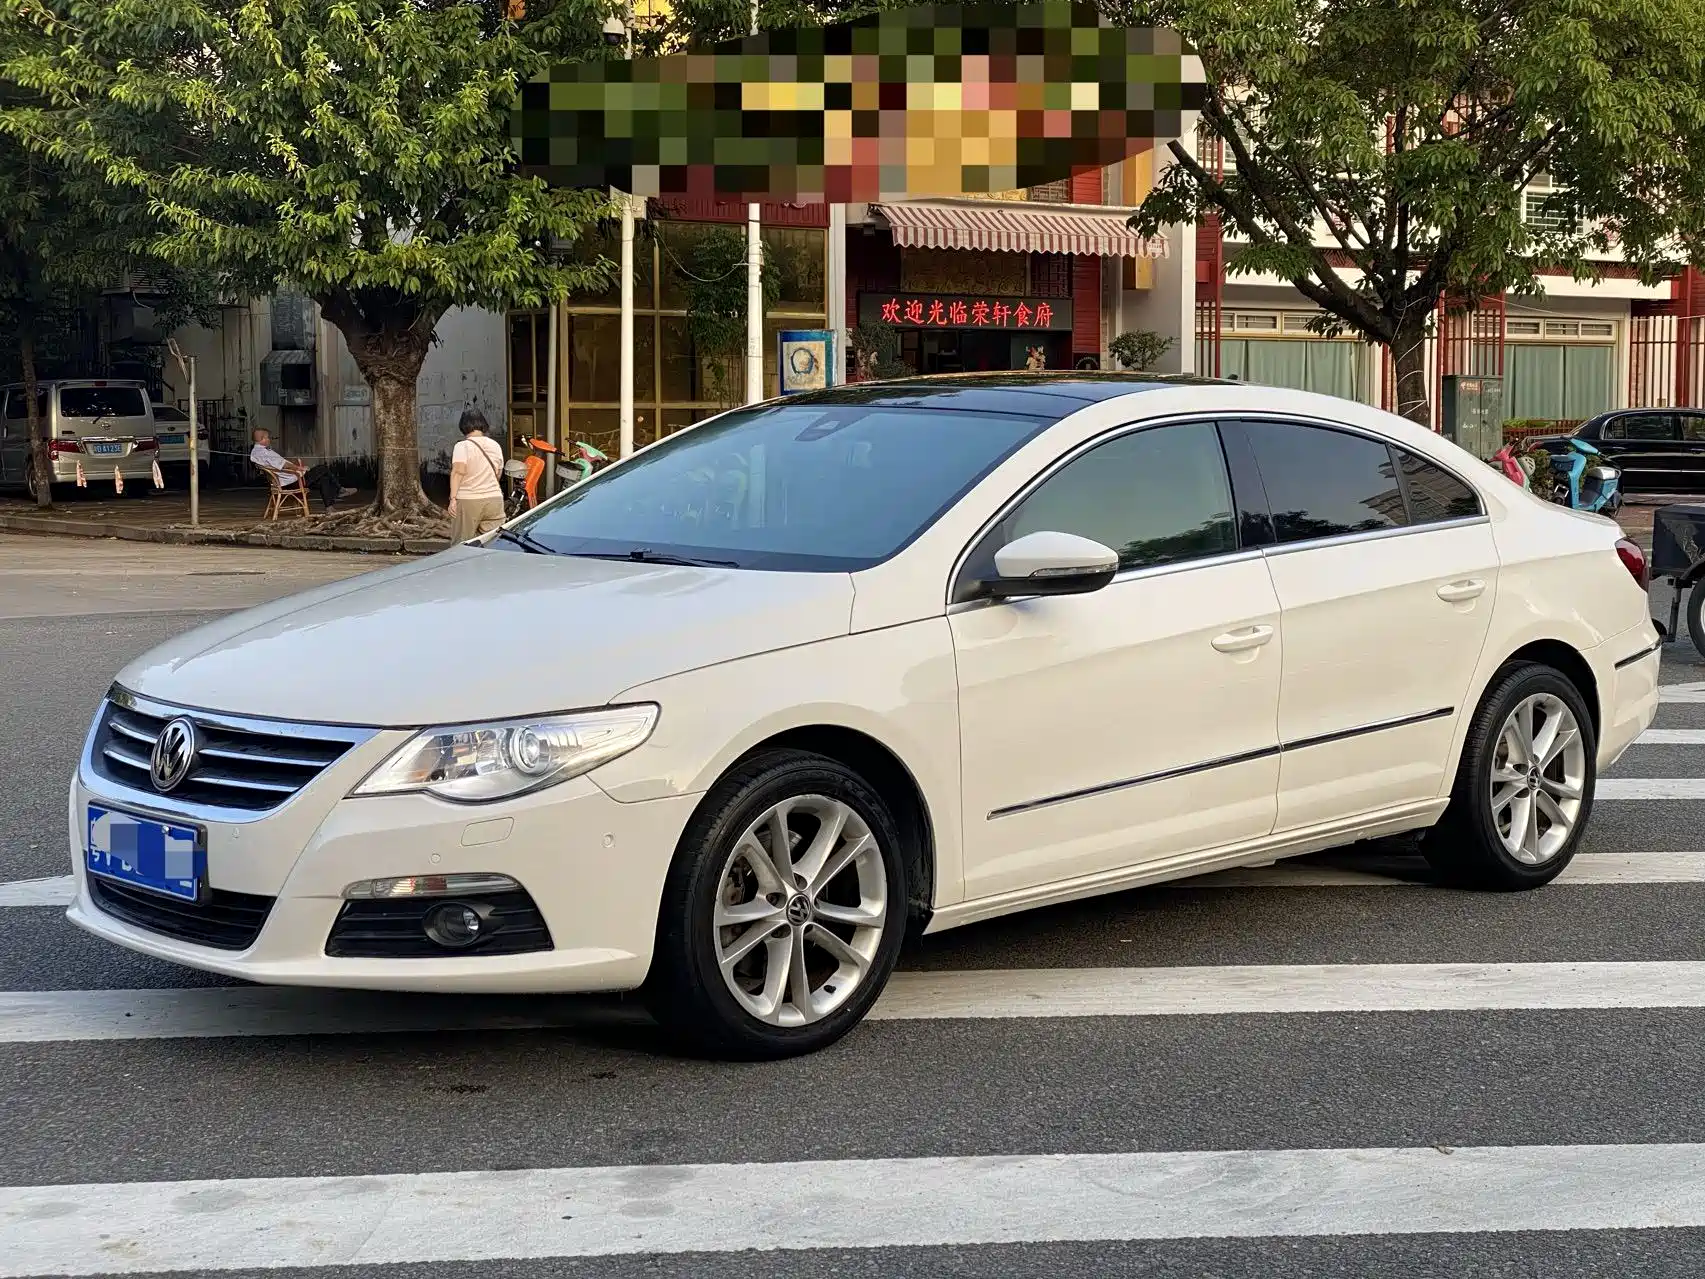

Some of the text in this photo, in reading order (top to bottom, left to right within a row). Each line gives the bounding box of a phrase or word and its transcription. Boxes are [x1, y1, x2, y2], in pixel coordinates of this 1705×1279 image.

[881, 297, 1054, 328] 欢迎光临荣轩食府
